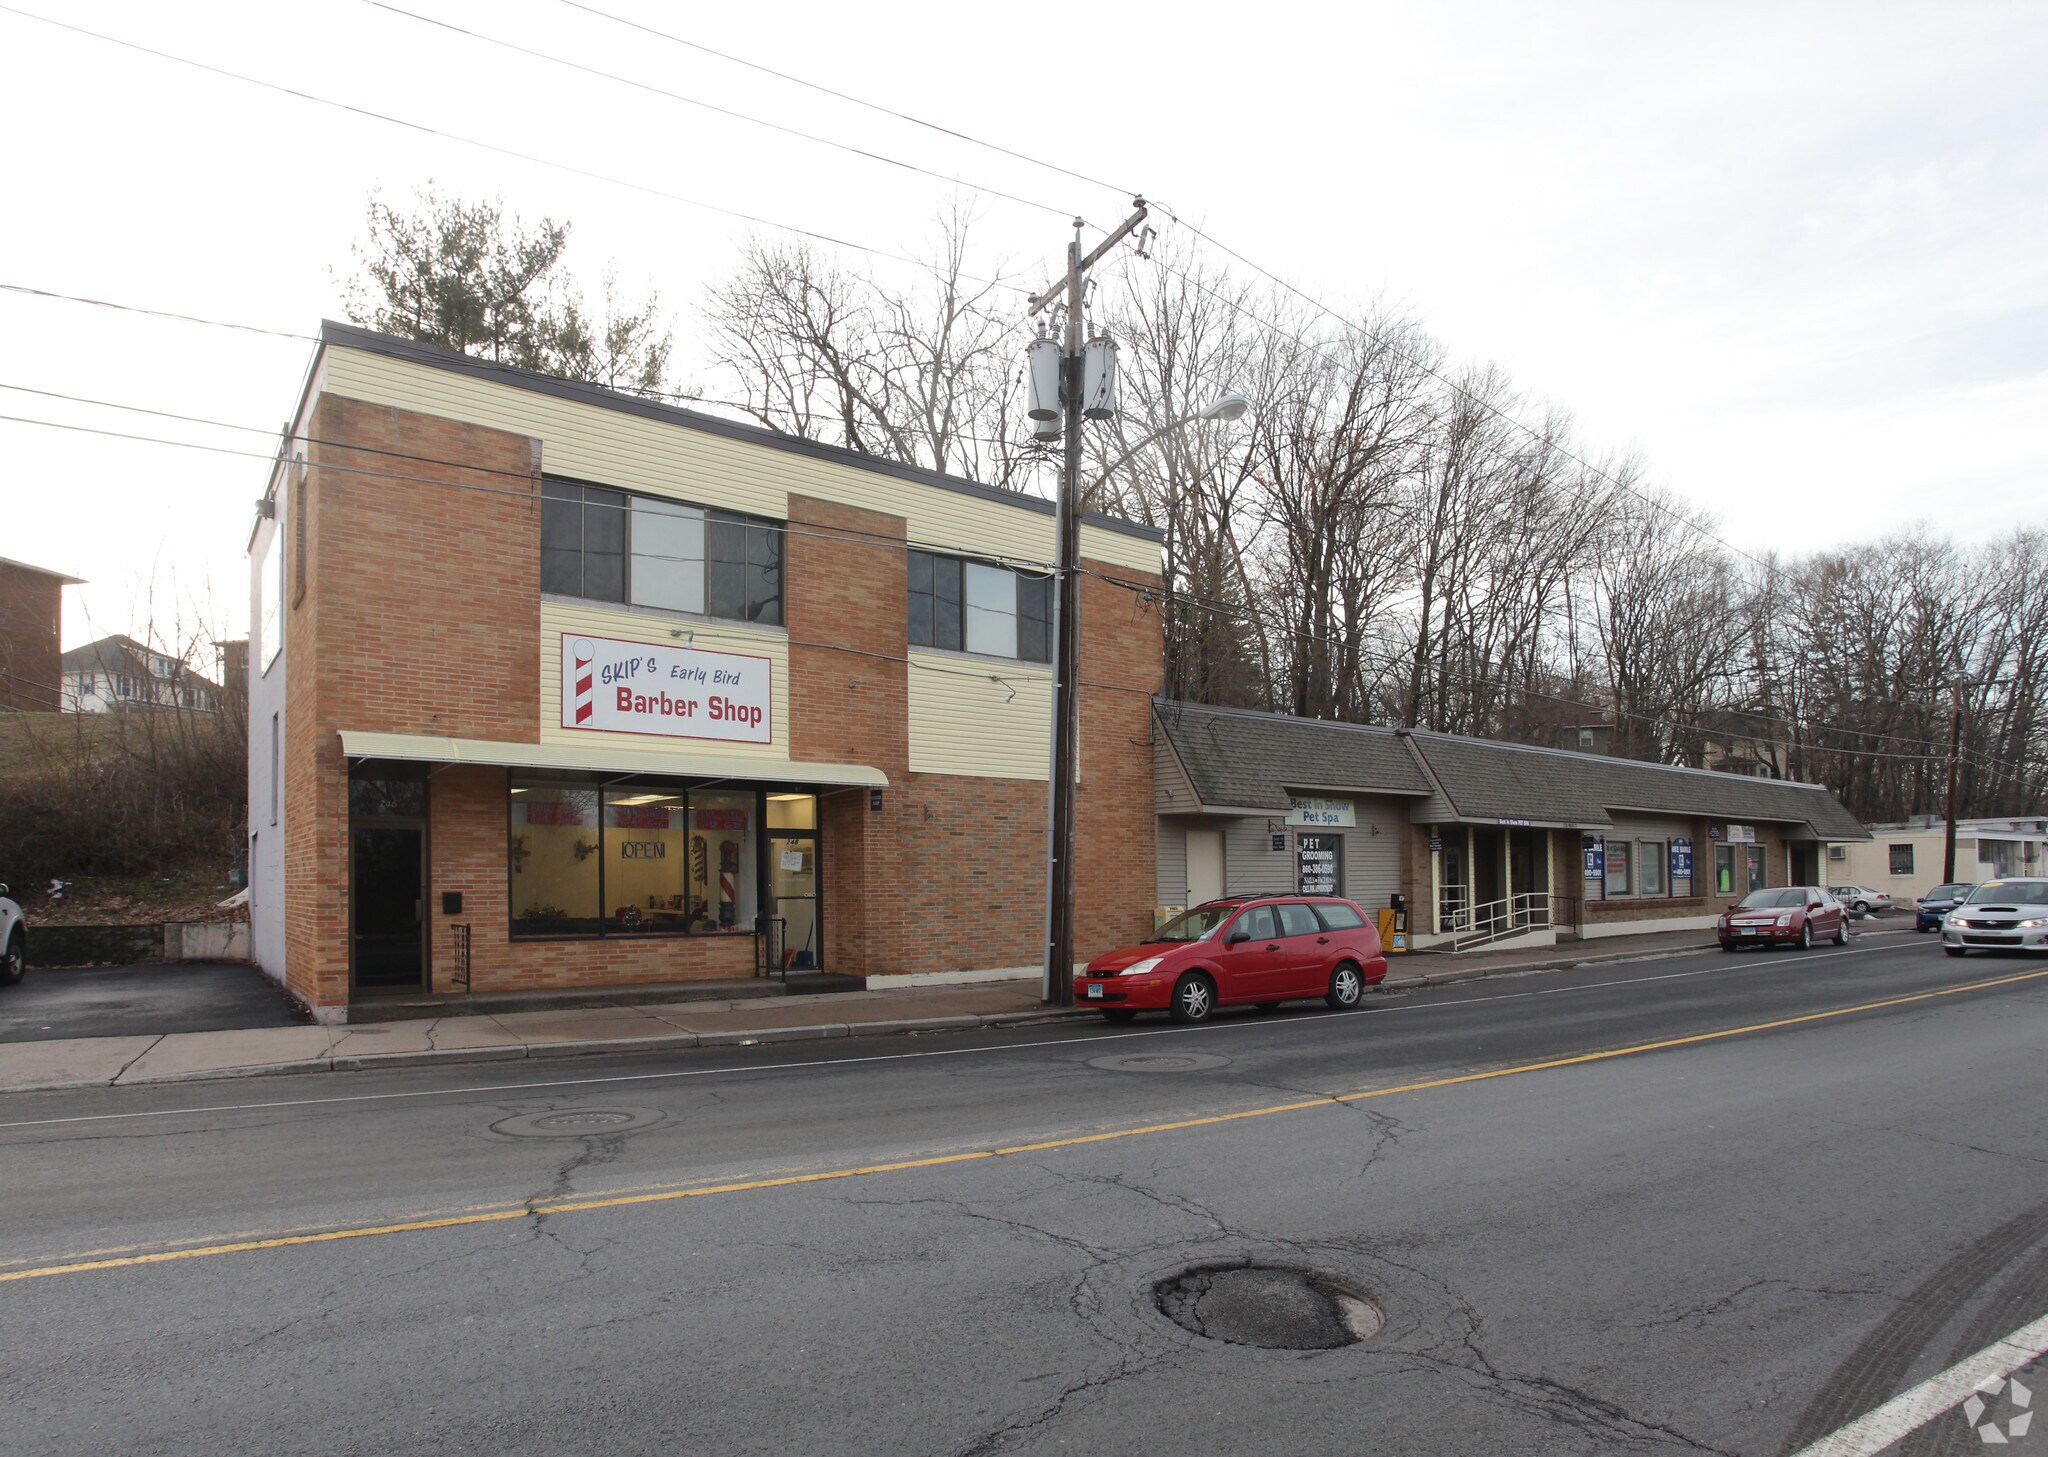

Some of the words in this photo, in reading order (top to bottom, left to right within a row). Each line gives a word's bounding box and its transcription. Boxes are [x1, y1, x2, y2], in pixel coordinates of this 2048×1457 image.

[601, 657, 657, 684] SKIP'S
[670, 664, 707, 685] Early
[713, 669, 741, 685] Bird
[616, 686, 699, 717] Barber
[708, 695, 762, 728] Shop
[1290, 798, 1311, 809] Best
[1325, 800, 1349, 811] Show
[1303, 811, 1320, 822] Pet
[1322, 811, 1339, 825] Spa
[624, 842, 663, 859] OPEN
[1303, 838, 1320, 849] PET
[1302, 851, 1333, 860] GROOMING
